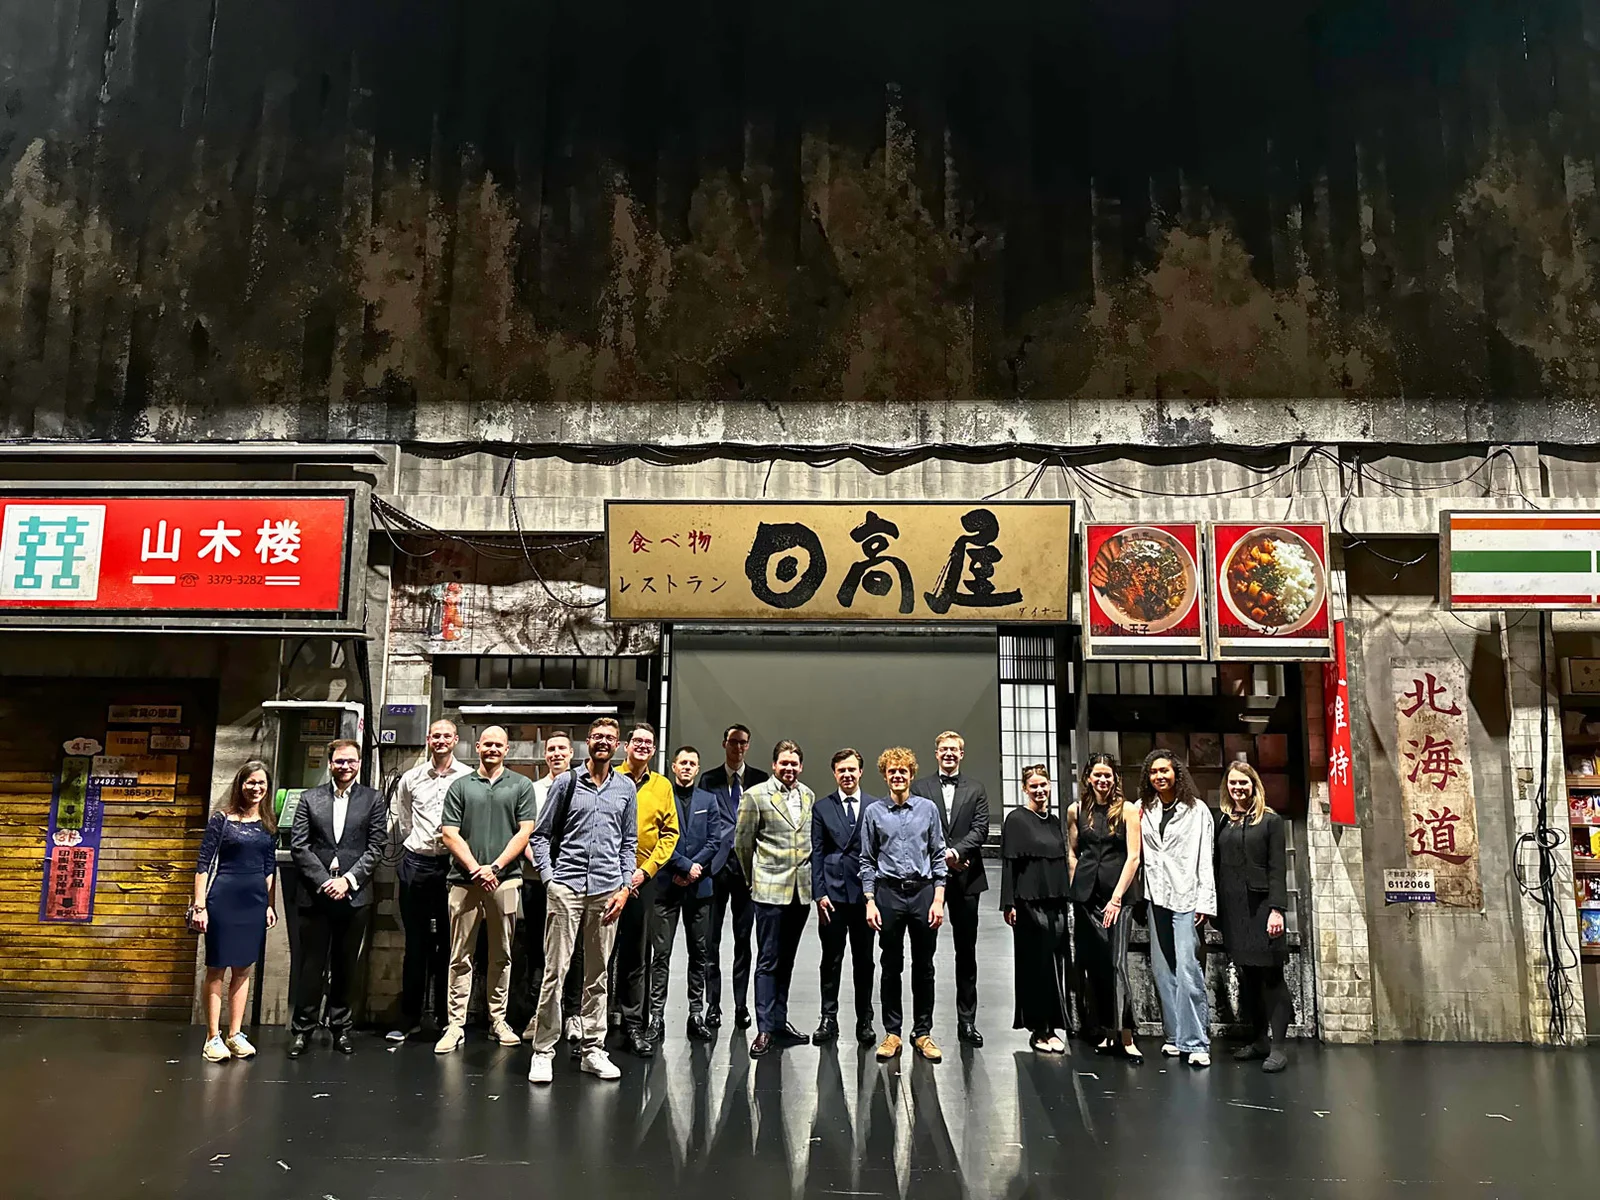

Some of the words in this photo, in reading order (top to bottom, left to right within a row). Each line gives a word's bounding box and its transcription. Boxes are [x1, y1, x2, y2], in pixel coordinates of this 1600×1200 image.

[141, 519, 301, 564] 山木楼
[628, 530, 712, 554] 食べ物
[745, 508, 1023, 613] 日高屋
[207, 574, 263, 585] 3379-3282
[619, 575, 728, 594] レストラン
[71, 742, 92, 751] 4F
[1401, 673, 1472, 865] 北海道
[1388, 880, 1430, 888] 6112066
